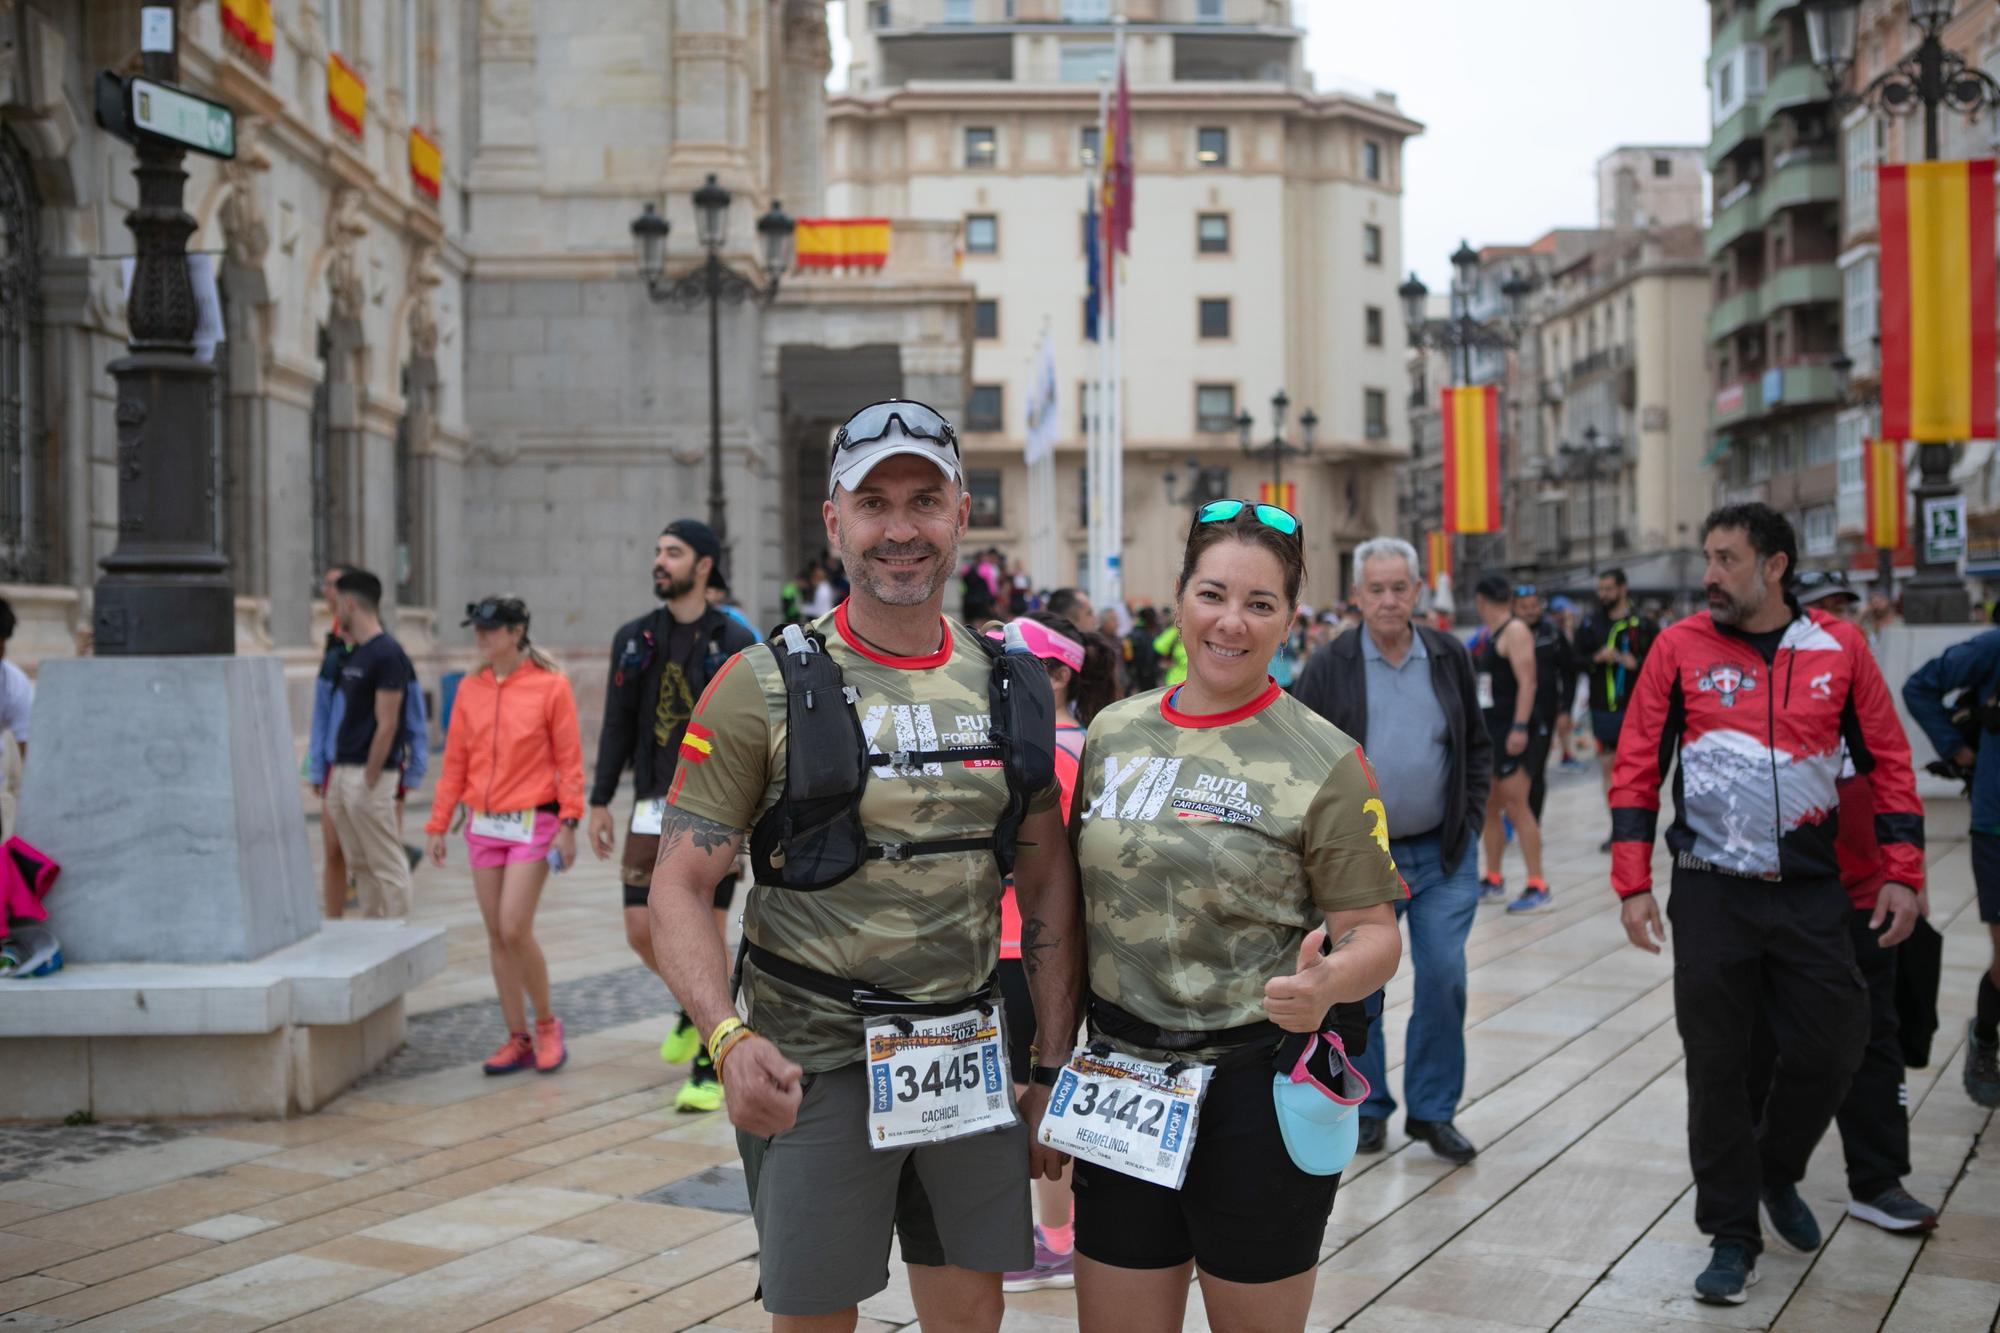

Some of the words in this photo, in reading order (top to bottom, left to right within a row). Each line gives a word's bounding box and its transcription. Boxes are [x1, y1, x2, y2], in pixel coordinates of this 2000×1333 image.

[955, 714, 992, 731] RUT
[1081, 756, 1183, 821] XII
[1194, 773, 1247, 799] RUTA
[1171, 787, 1262, 817] FORTALEZAS
[1172, 799, 1226, 816] CARTAGENA
[1226, 811, 1252, 823] 2023
[922, 1028, 933, 1037] DE
[935, 1025, 950, 1036] LAS
[951, 1025, 976, 1042] 2023
[895, 1052, 980, 1103] 3445
[1126, 1062, 1141, 1073] LAS
[1142, 1071, 1176, 1089] 2023
[878, 1076, 888, 1110] CAJON
[1053, 1081, 1073, 1113] CAJON
[921, 1104, 959, 1123] CACHICHI
[1072, 1082, 1165, 1137] 3442
[1076, 1127, 1129, 1155] HERMELINDA
[1165, 1113, 1182, 1149] CAJON
